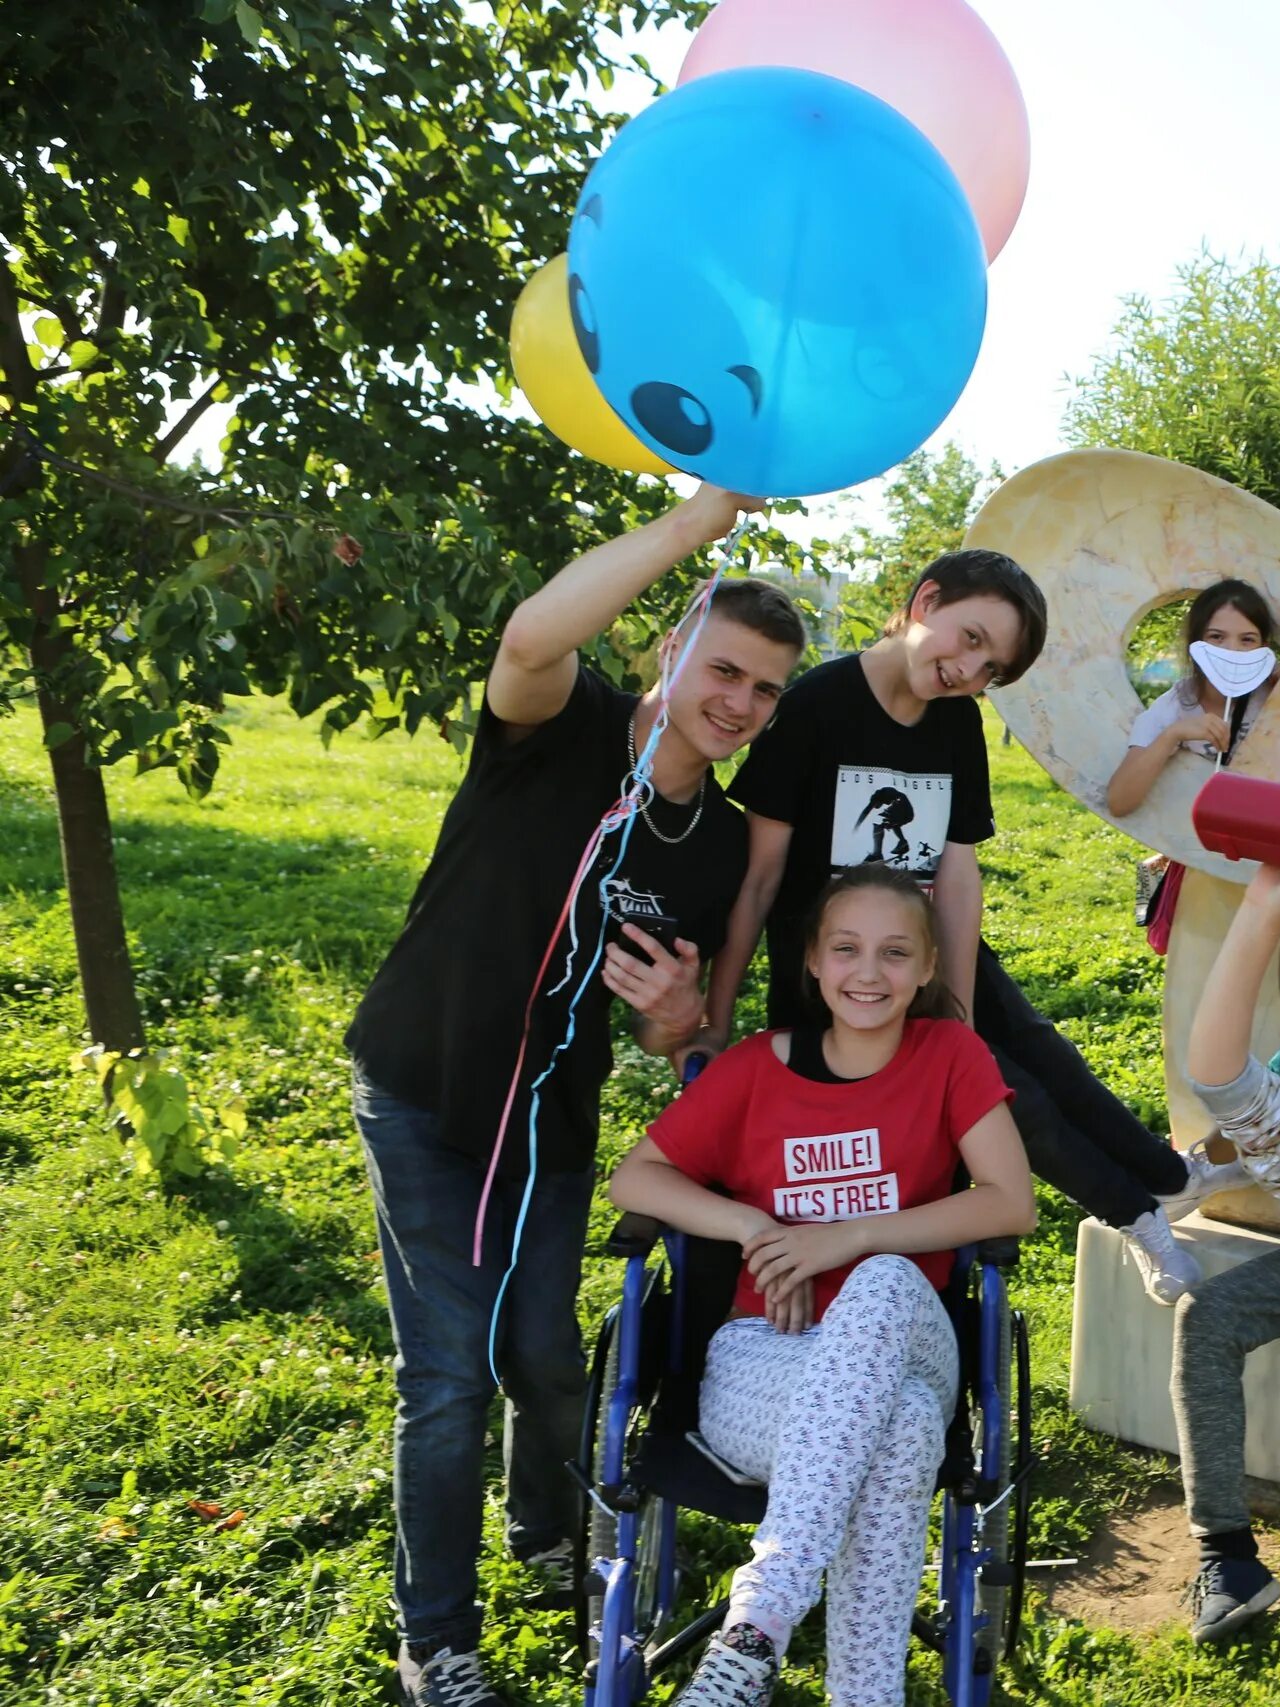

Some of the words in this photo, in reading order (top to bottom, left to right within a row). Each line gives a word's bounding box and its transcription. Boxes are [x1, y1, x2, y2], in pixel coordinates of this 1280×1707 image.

[841, 773, 874, 784] LOS
[792, 1135, 872, 1175] SMILE!
[783, 1190, 825, 1218] IT'S
[833, 1181, 890, 1215] FREE
